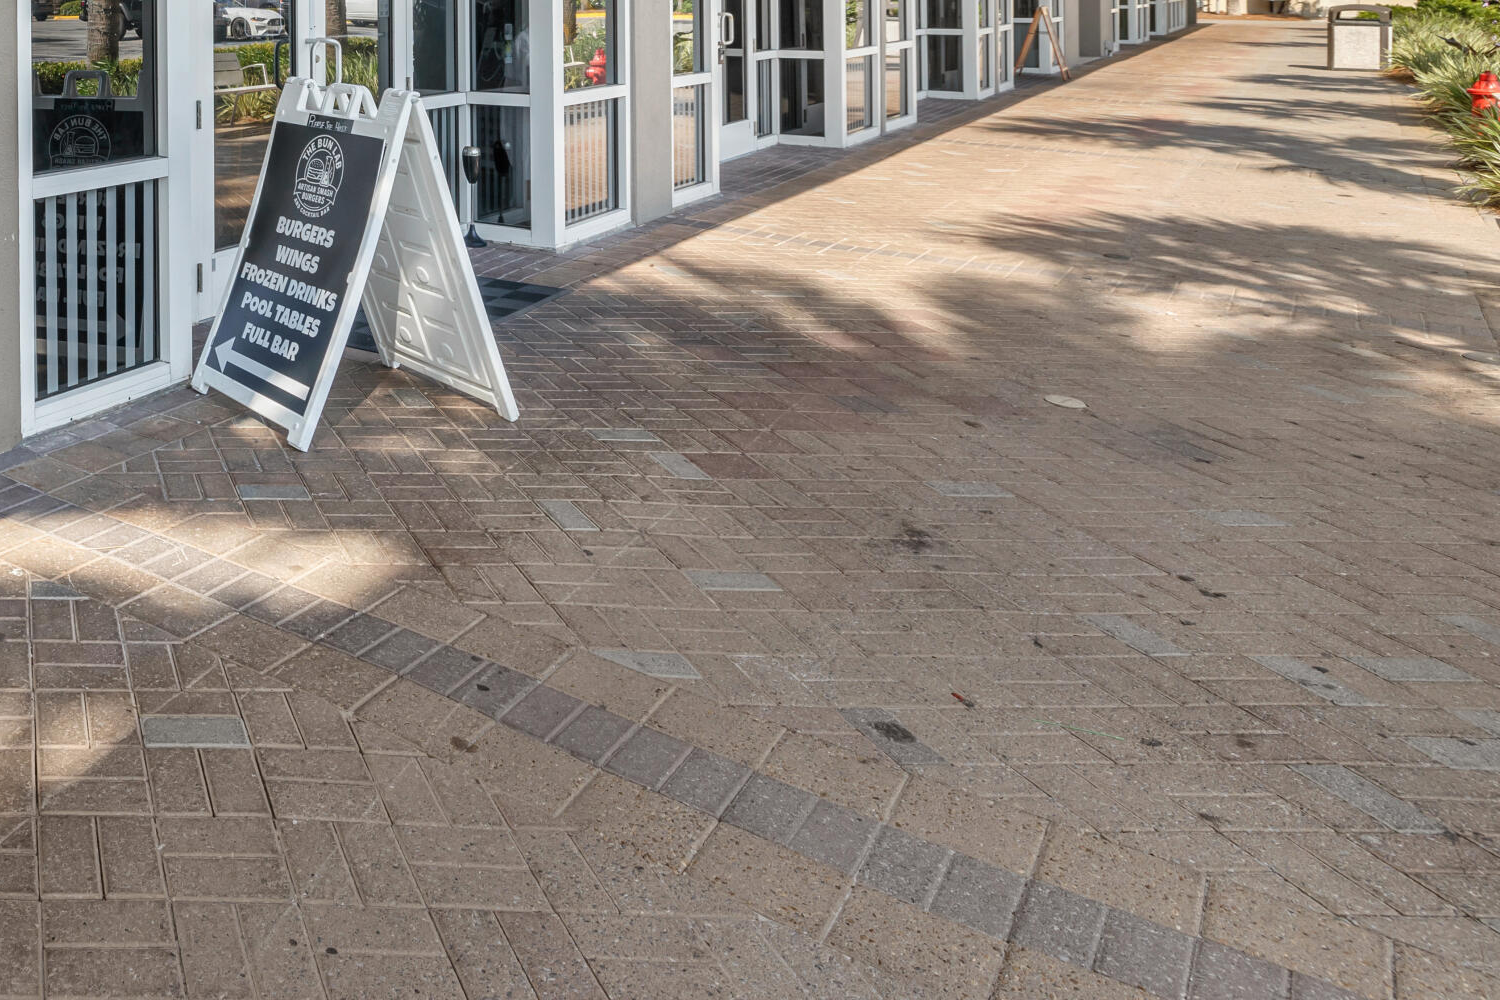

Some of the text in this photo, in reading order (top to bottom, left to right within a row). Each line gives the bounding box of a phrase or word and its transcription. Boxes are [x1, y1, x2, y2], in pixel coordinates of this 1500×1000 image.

[302, 138, 342, 170] THE BUN LAB
[297, 182, 334, 198] ARTISAN SMASH
[301, 192, 326, 205] BURGERS
[300, 207, 320, 218] COCKTAIL
[320, 206, 330, 217] BAR
[275, 216, 336, 249] BURGERS
[275, 244, 320, 275] WINGS
[240, 261, 338, 312] FROZEN DRINKS
[240, 291, 321, 338] POOL TABLES
[241, 322, 300, 362] FULL BAR
